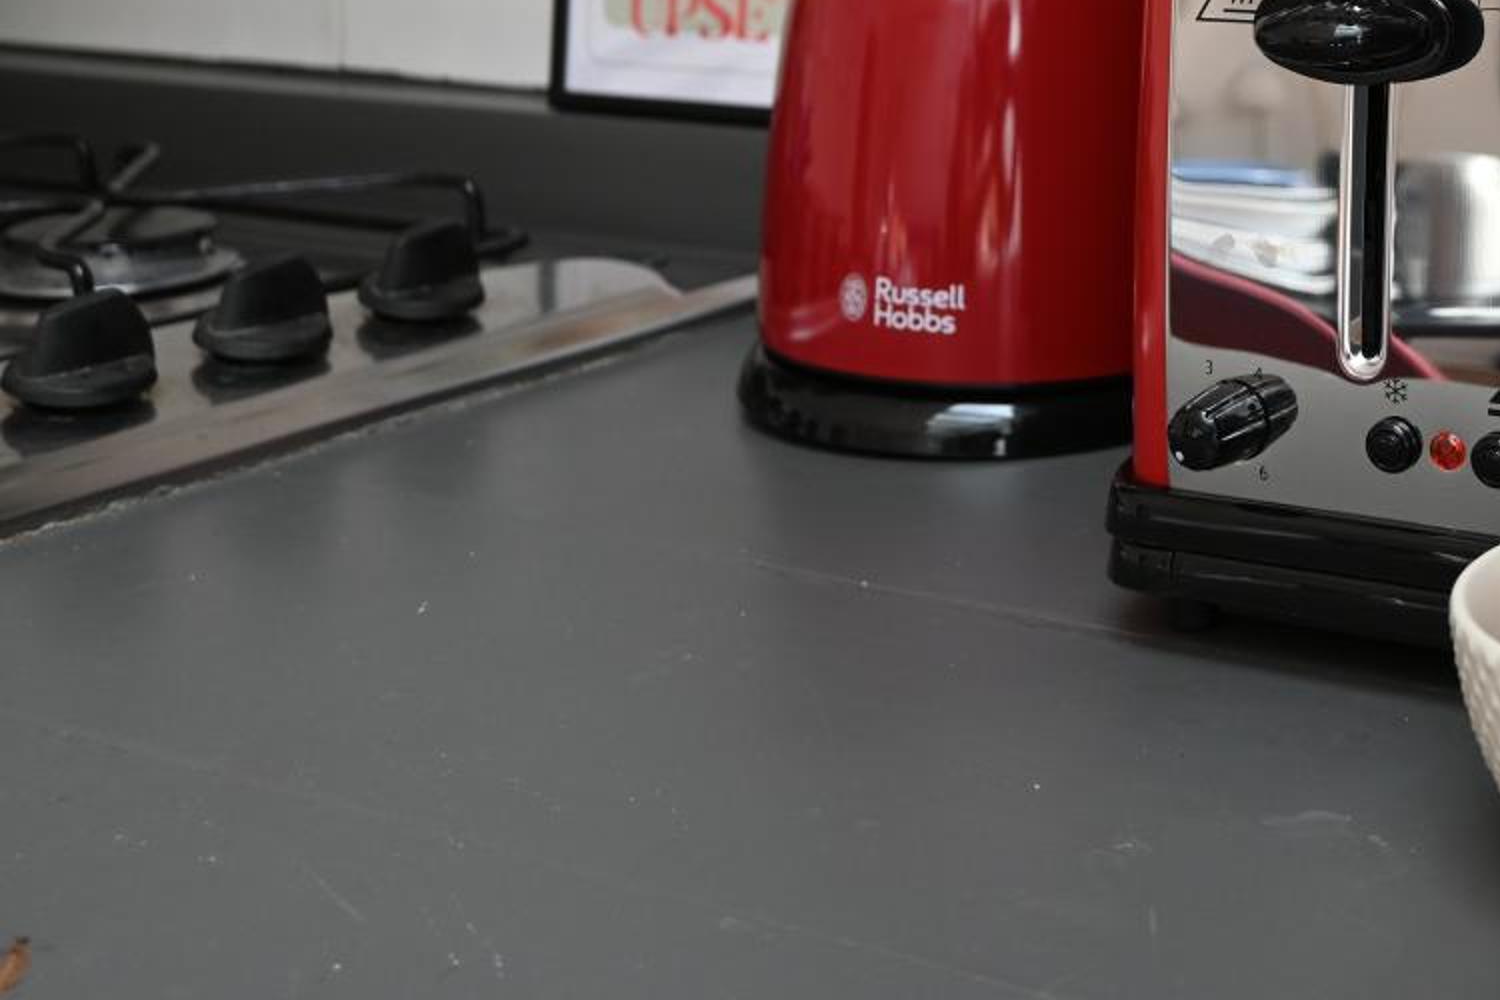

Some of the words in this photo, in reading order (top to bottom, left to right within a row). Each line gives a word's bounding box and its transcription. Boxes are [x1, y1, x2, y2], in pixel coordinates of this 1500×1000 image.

[875, 276, 966, 311] Russell
[873, 301, 957, 336] Hobbs
[1204, 359, 1213, 375] 3
